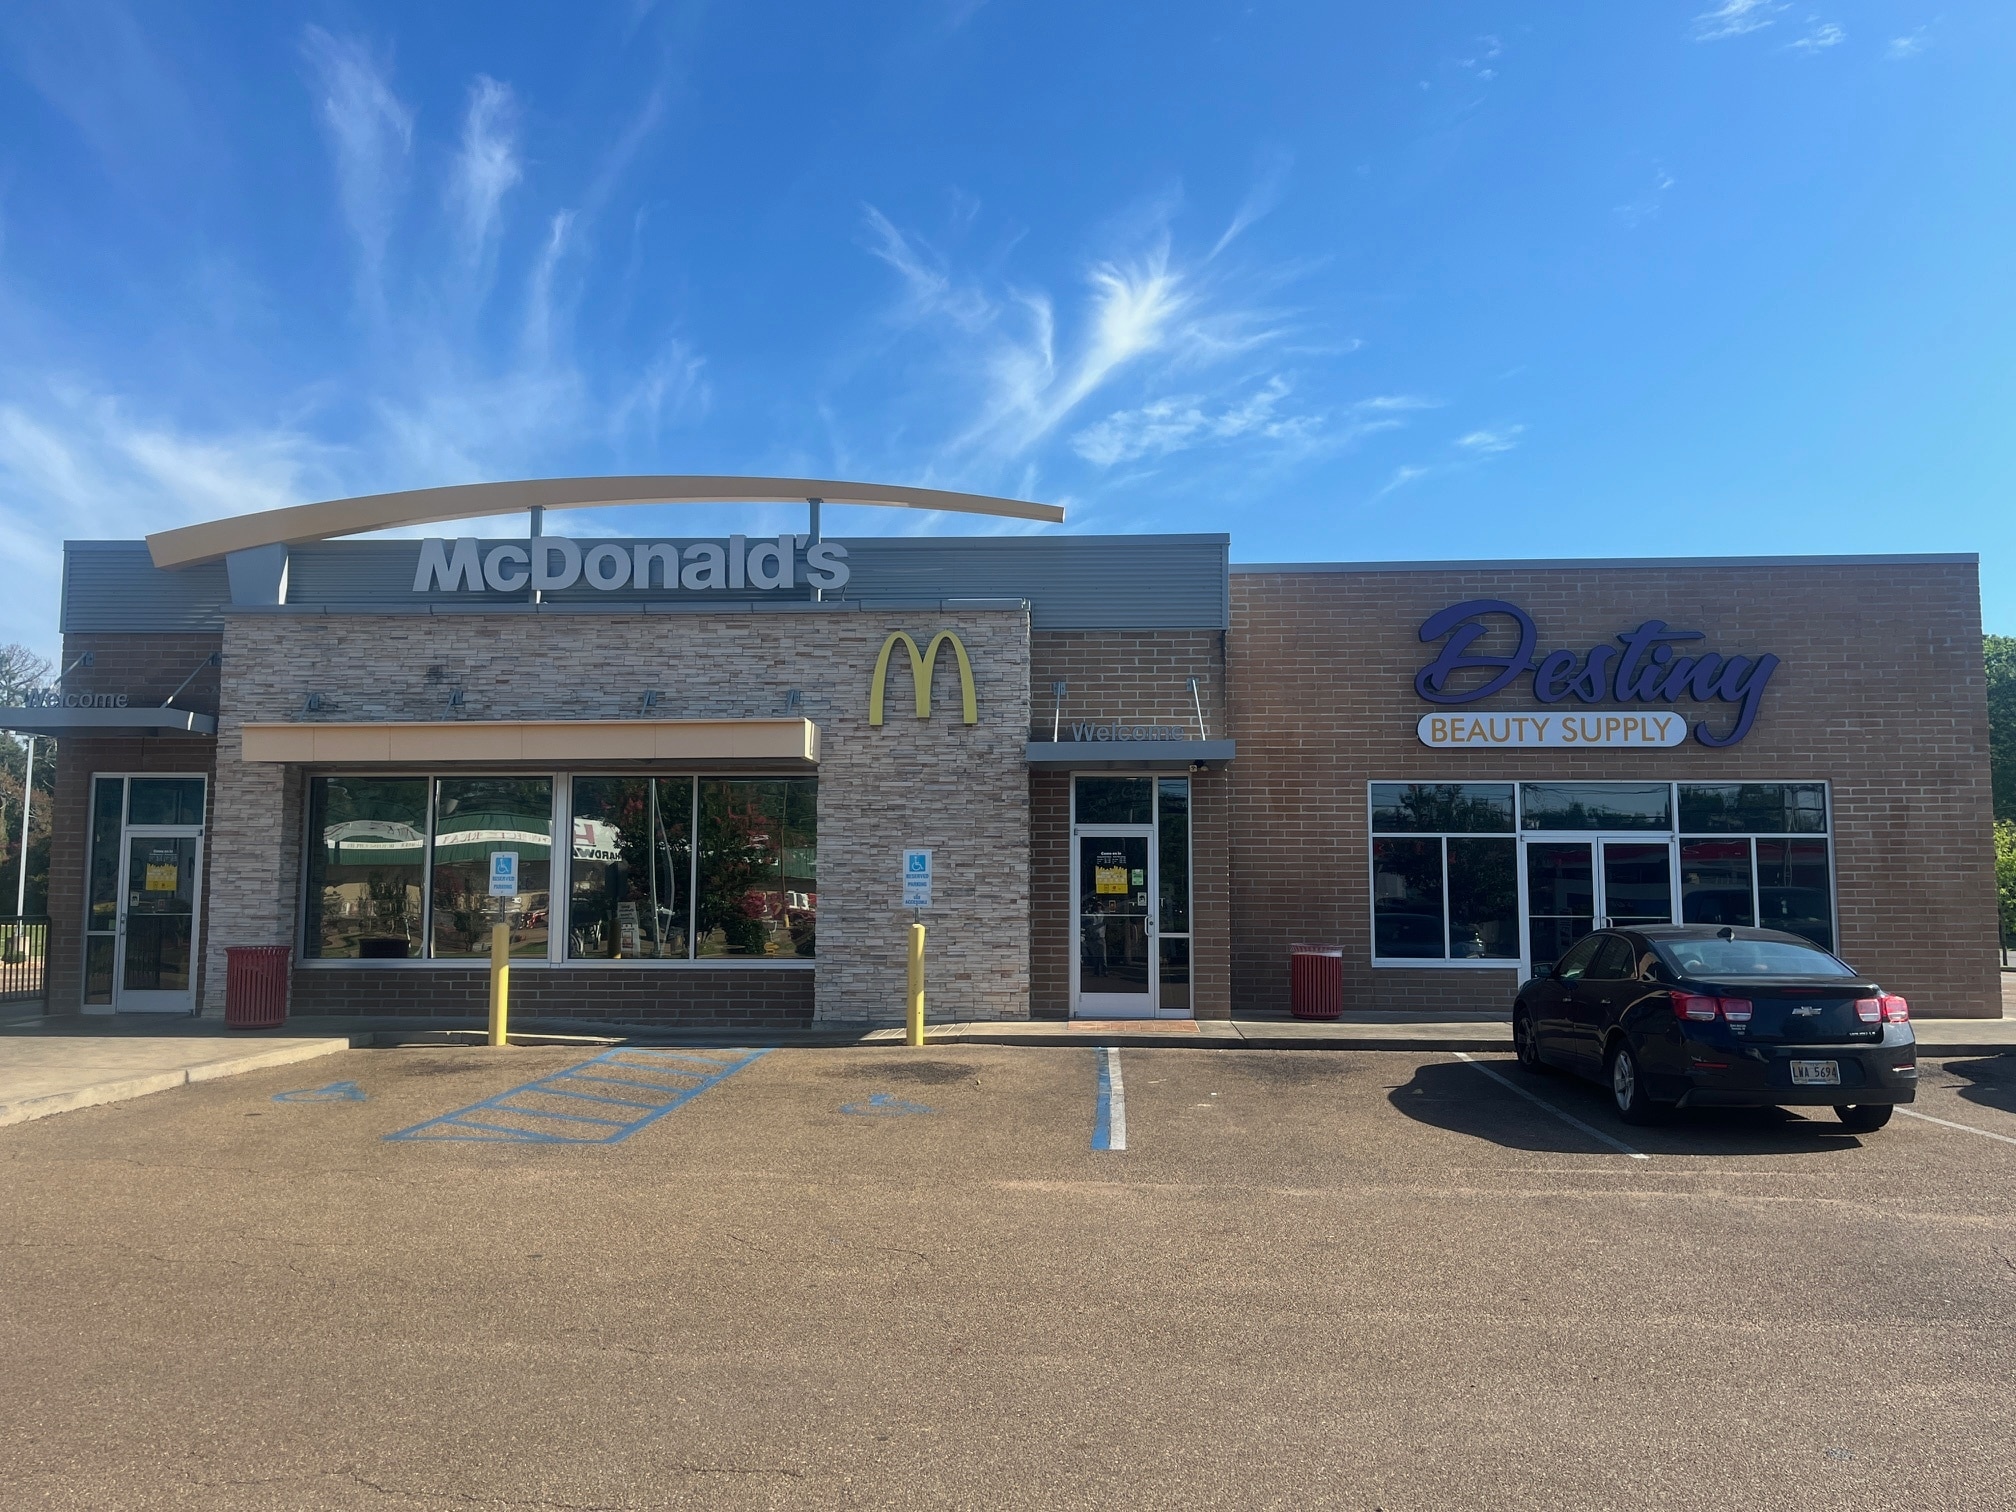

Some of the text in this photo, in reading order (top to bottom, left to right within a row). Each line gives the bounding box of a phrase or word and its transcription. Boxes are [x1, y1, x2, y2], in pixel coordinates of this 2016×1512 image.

[412, 534, 851, 592] McDonald's
[1414, 599, 1781, 748] Destiny
[25, 687, 129, 708] Welcome
[1071, 721, 1185, 742] Welcome
[1431, 716, 1672, 743] BEAUTY SUPPLY
[1792, 1066, 1838, 1078] LWA 5694
